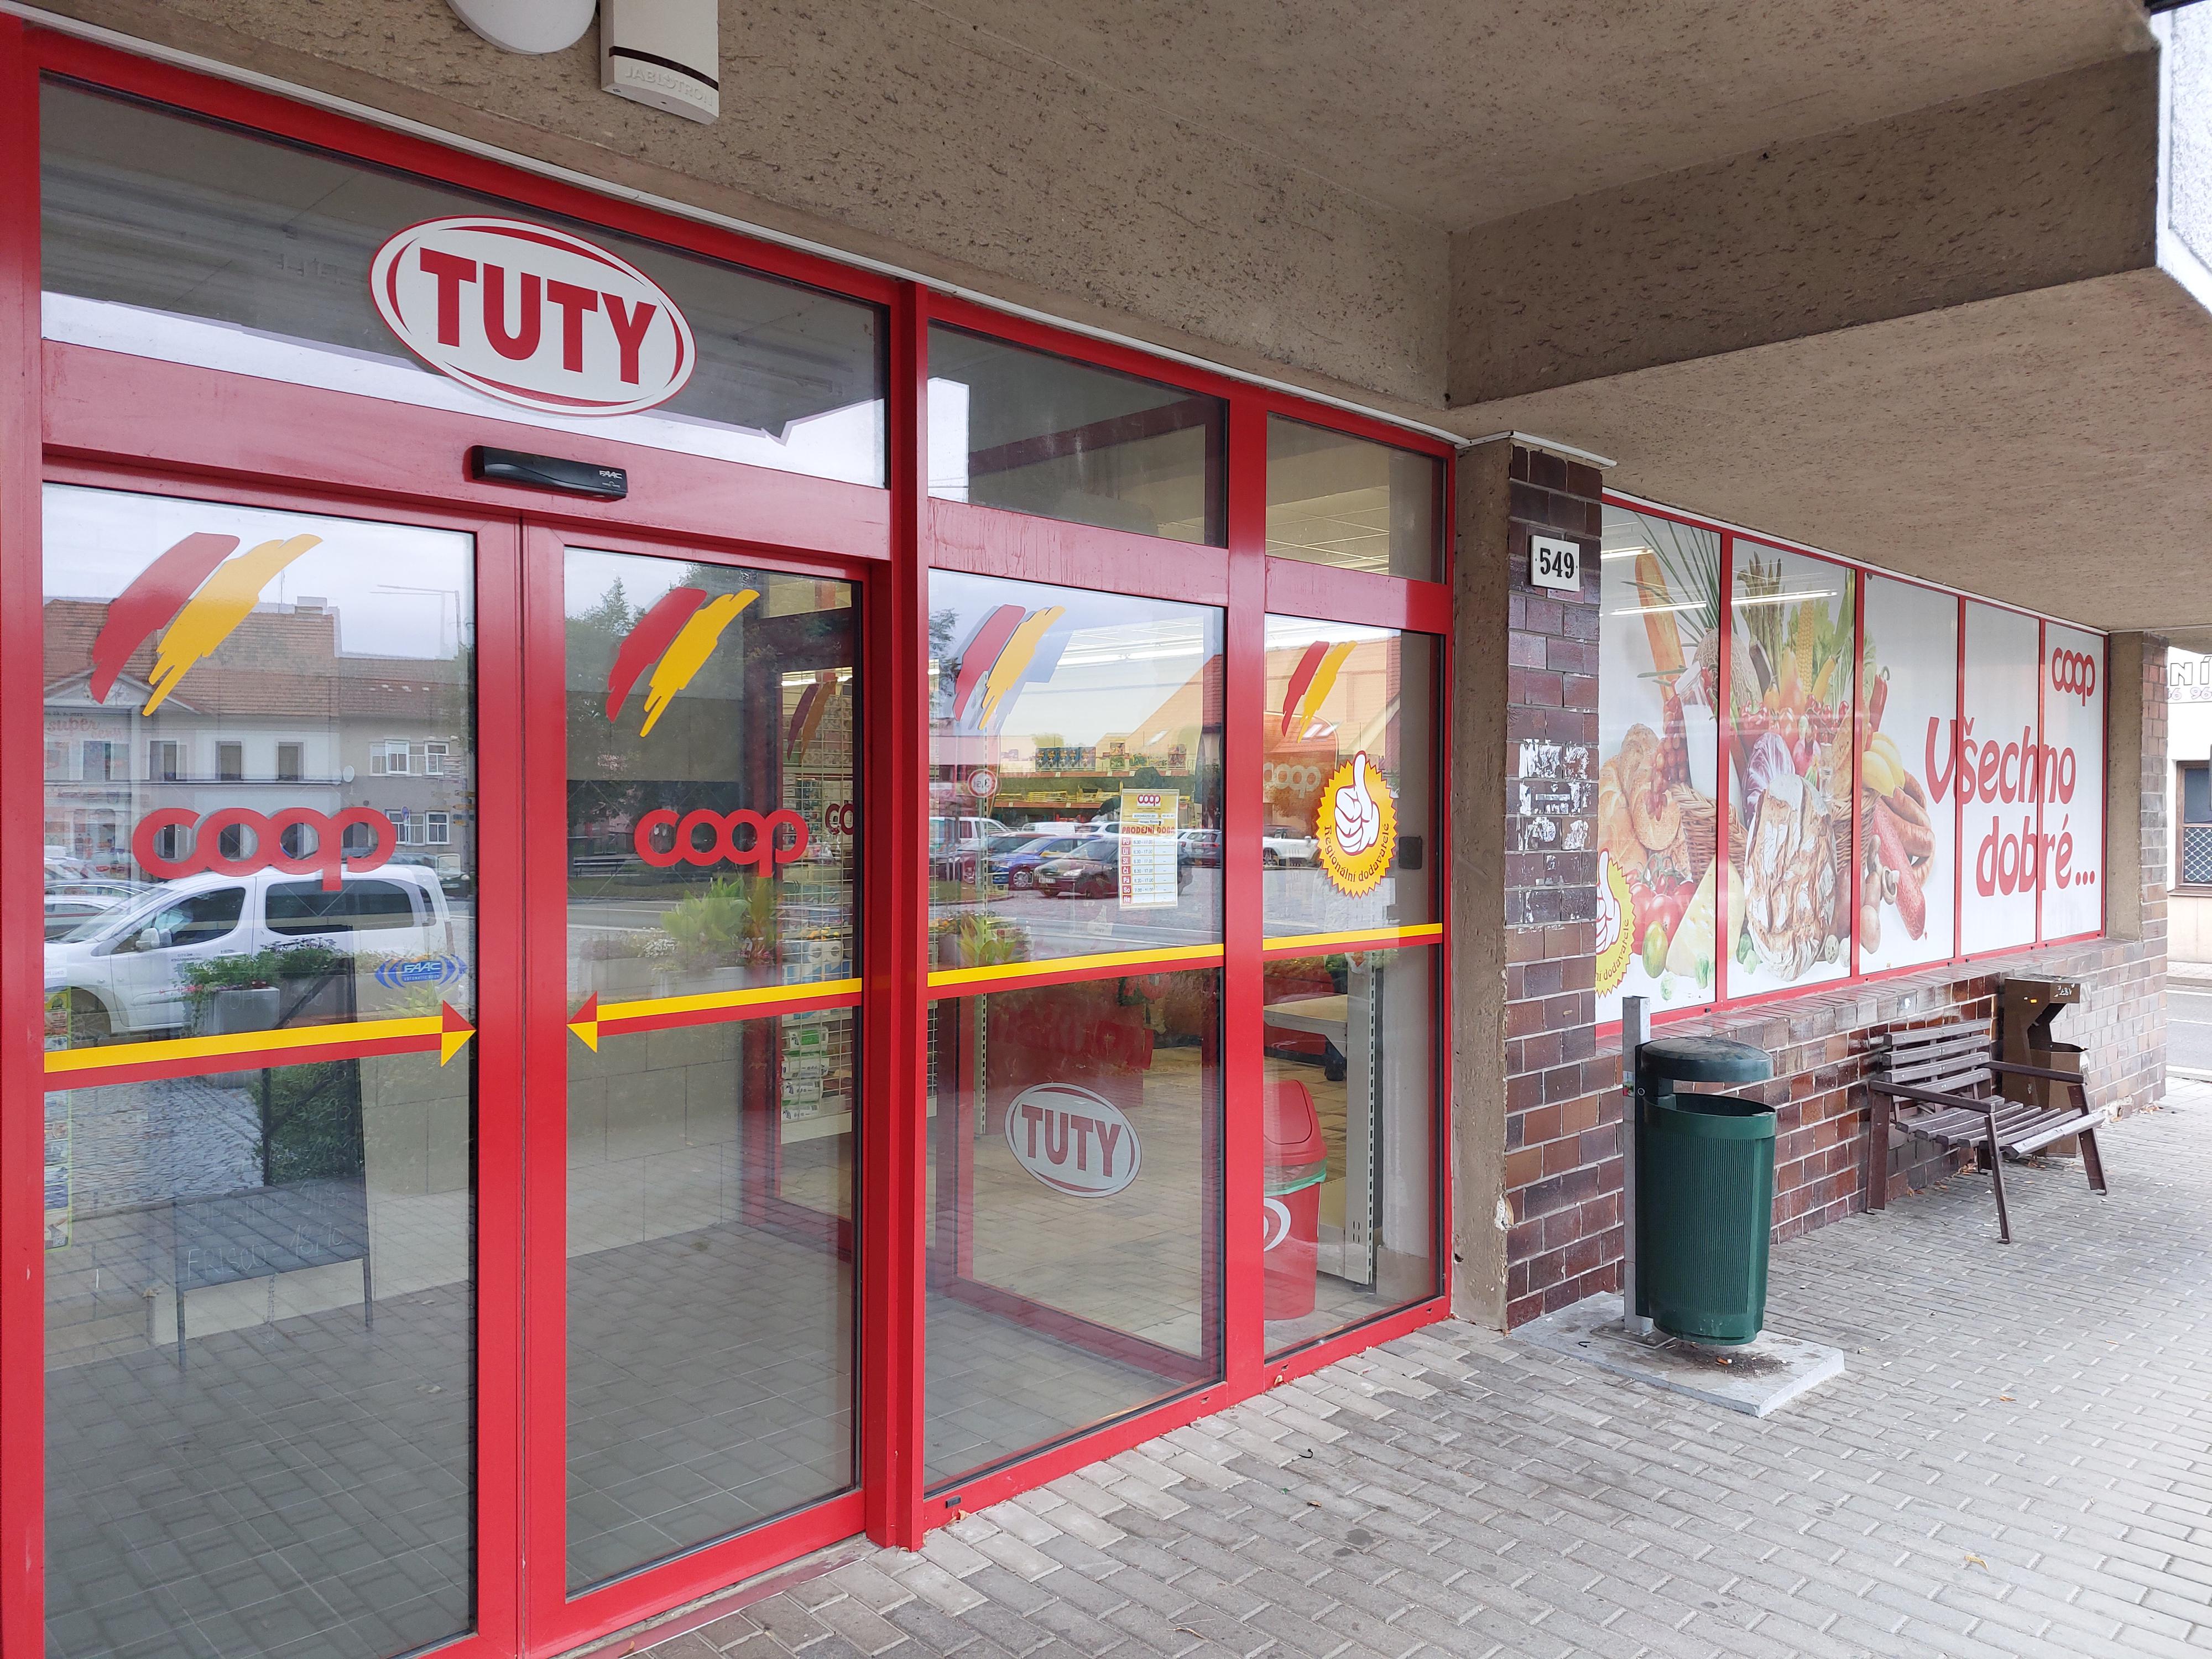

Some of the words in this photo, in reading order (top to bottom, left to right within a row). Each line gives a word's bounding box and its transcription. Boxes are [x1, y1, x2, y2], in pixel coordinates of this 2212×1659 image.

[625, 66, 713, 106] JABLOTRON
[420, 247, 657, 385] TUTY
[1540, 547, 1574, 578] 549
[2052, 647, 2096, 707] coop
[1925, 717, 2077, 805] Všechno
[1138, 795, 1161, 807] coop
[132, 807, 397, 891] coop
[634, 808, 809, 878] coop
[1324, 825, 1356, 883] Regionální
[1358, 823, 1389, 882] dodavatelé
[404, 962, 442, 973] FAAC
[1022, 1104, 1121, 1177] TUTY
